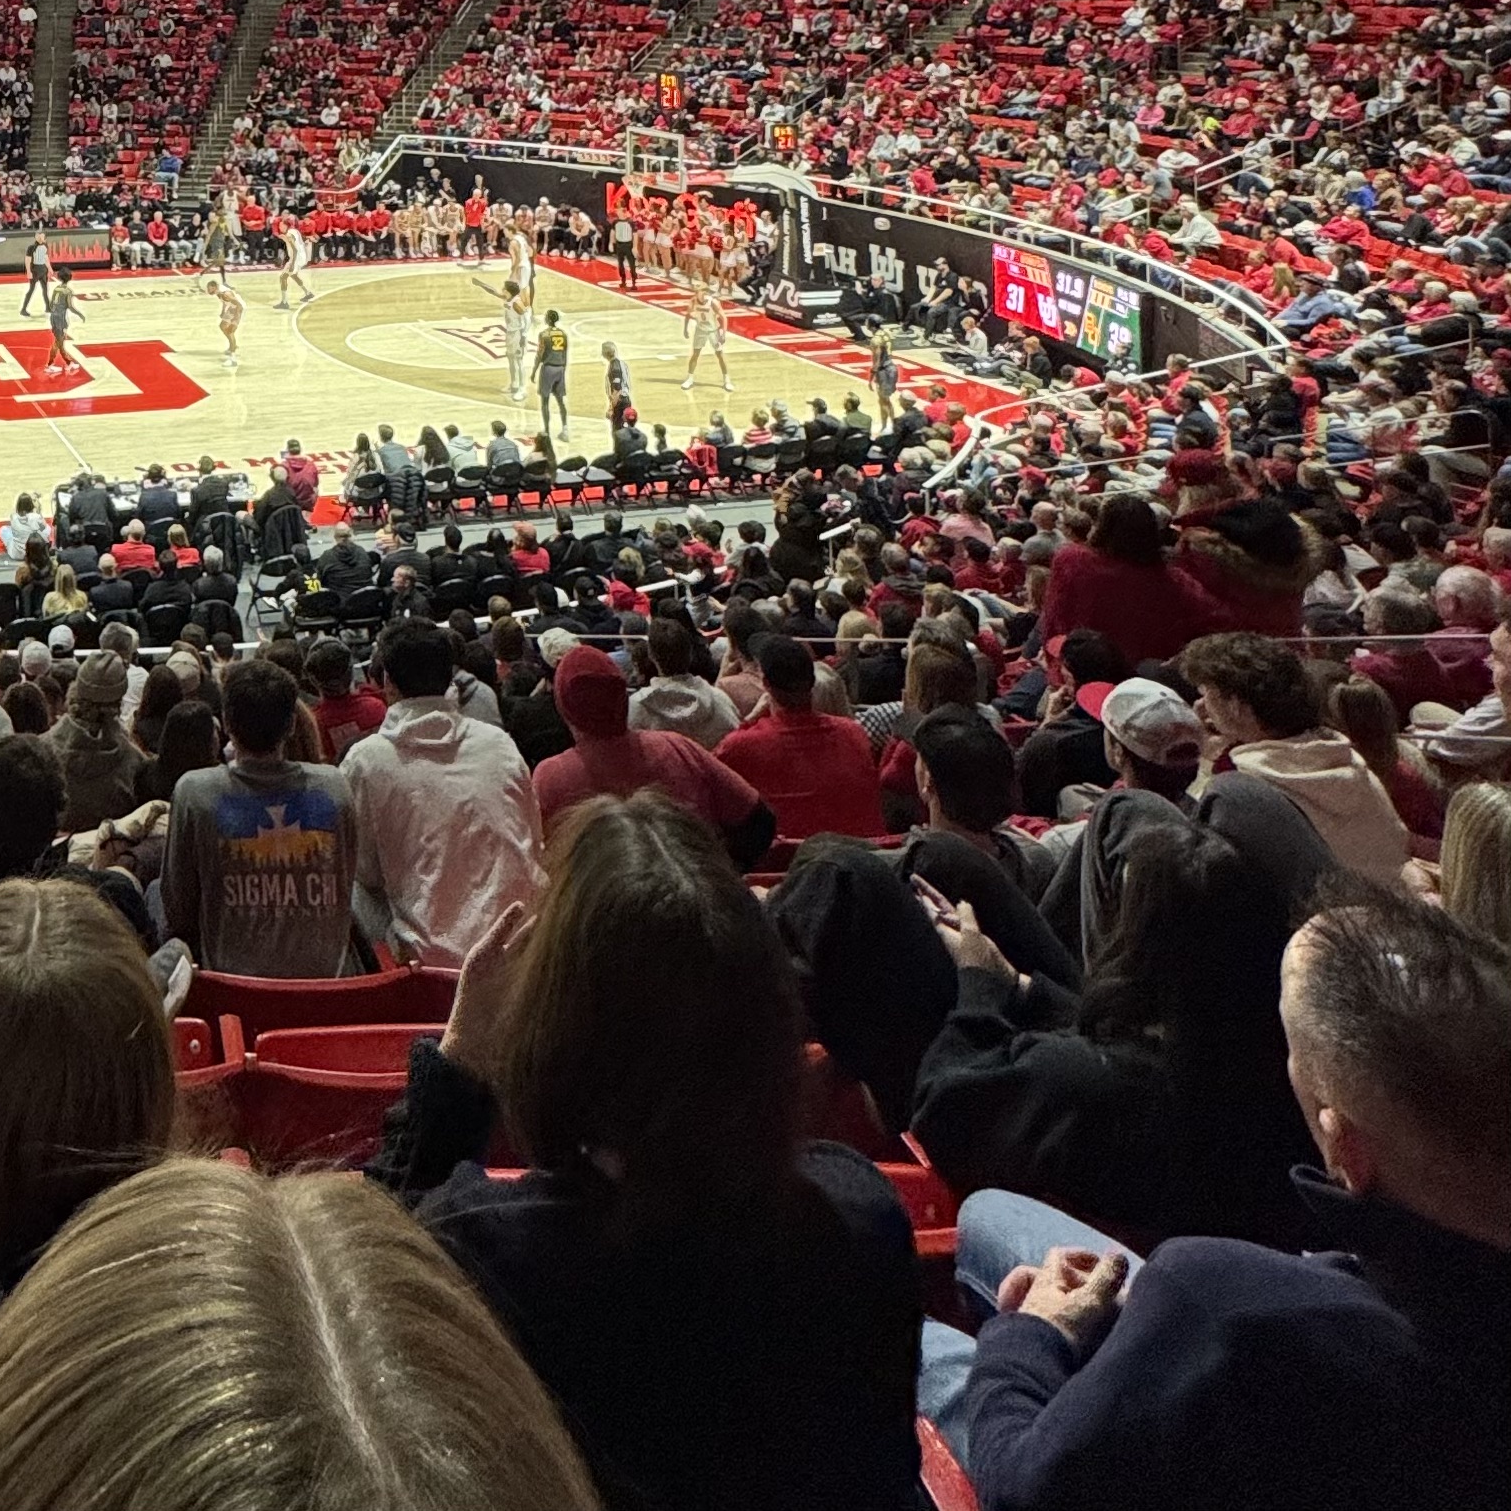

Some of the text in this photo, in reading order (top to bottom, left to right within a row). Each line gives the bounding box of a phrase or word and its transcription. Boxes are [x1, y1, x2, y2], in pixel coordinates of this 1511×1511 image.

[1005, 283, 1025, 313] 31
[552, 336, 564, 351] 32
[223, 873, 299, 907] SIGMA
